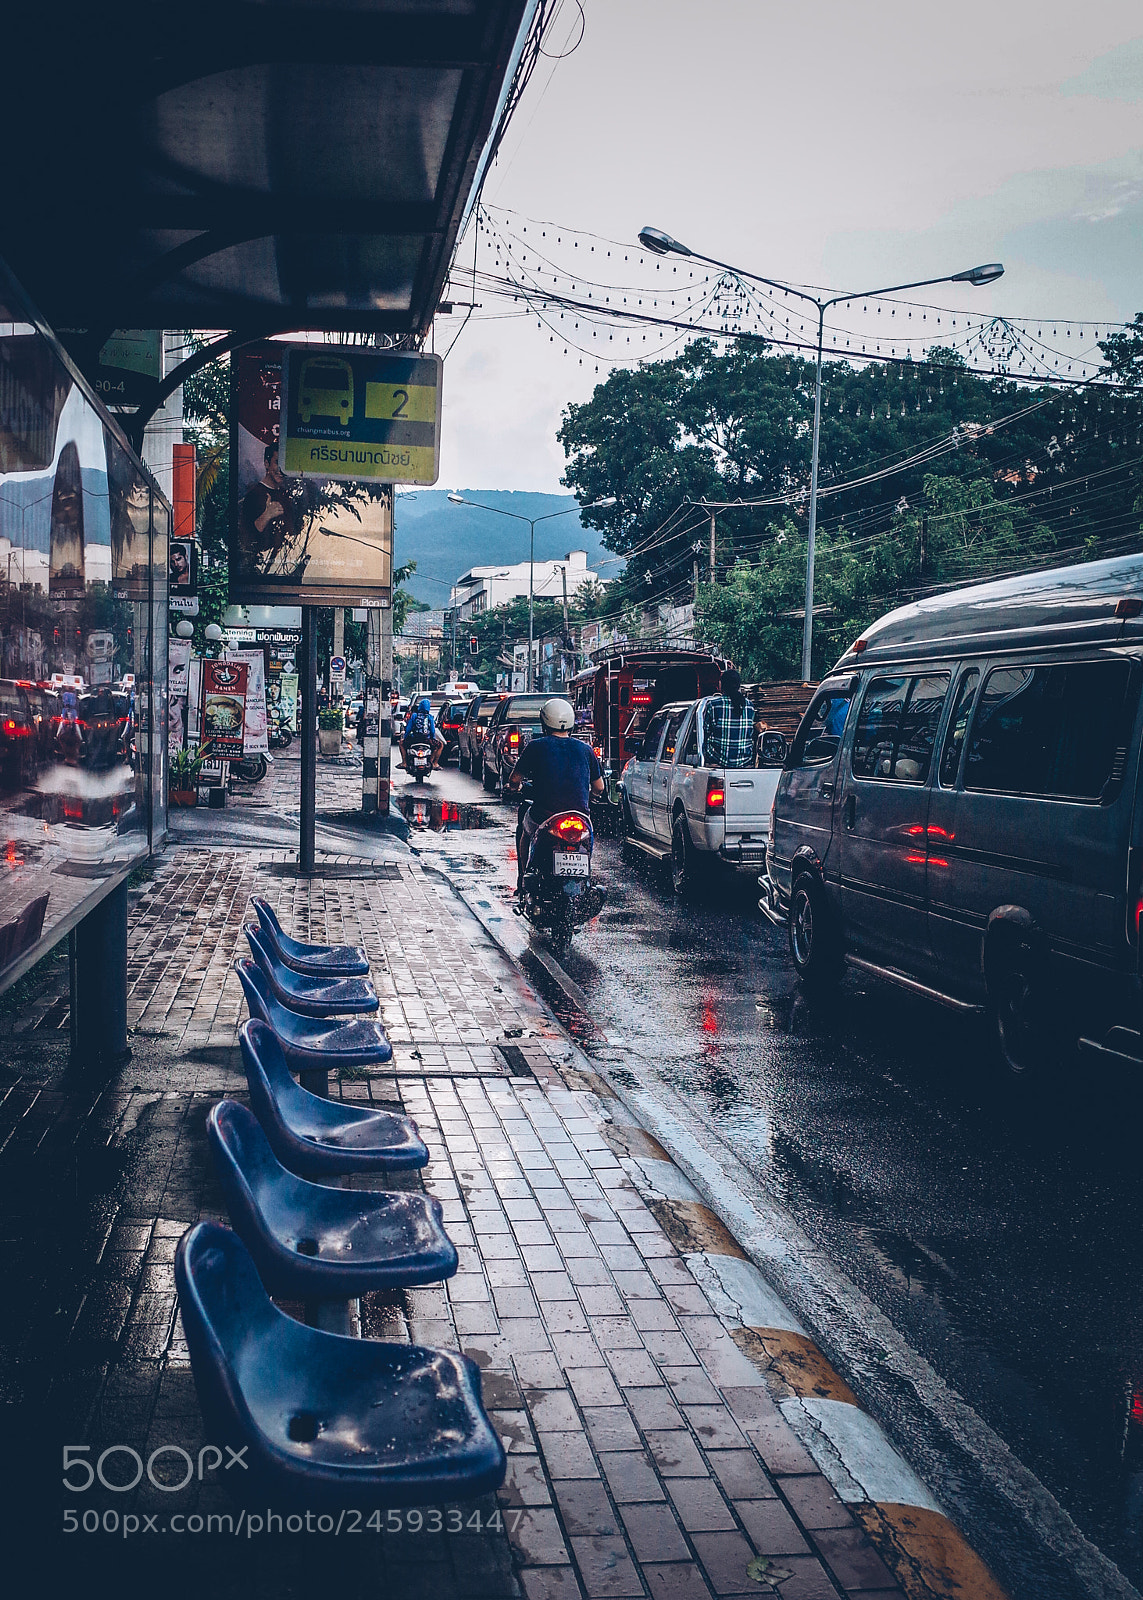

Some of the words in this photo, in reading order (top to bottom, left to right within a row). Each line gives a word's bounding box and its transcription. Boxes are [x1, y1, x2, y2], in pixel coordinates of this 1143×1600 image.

[391, 389, 409, 419] 2
[297, 426, 351, 438] chiangmaibus.org
[310, 445, 411, 467] ศรีธนาพาณิชย์
[257, 631, 300, 642] ฟอกฟันขาว
[214, 684, 236, 692] RAMEN
[559, 867, 585, 875] 2072
